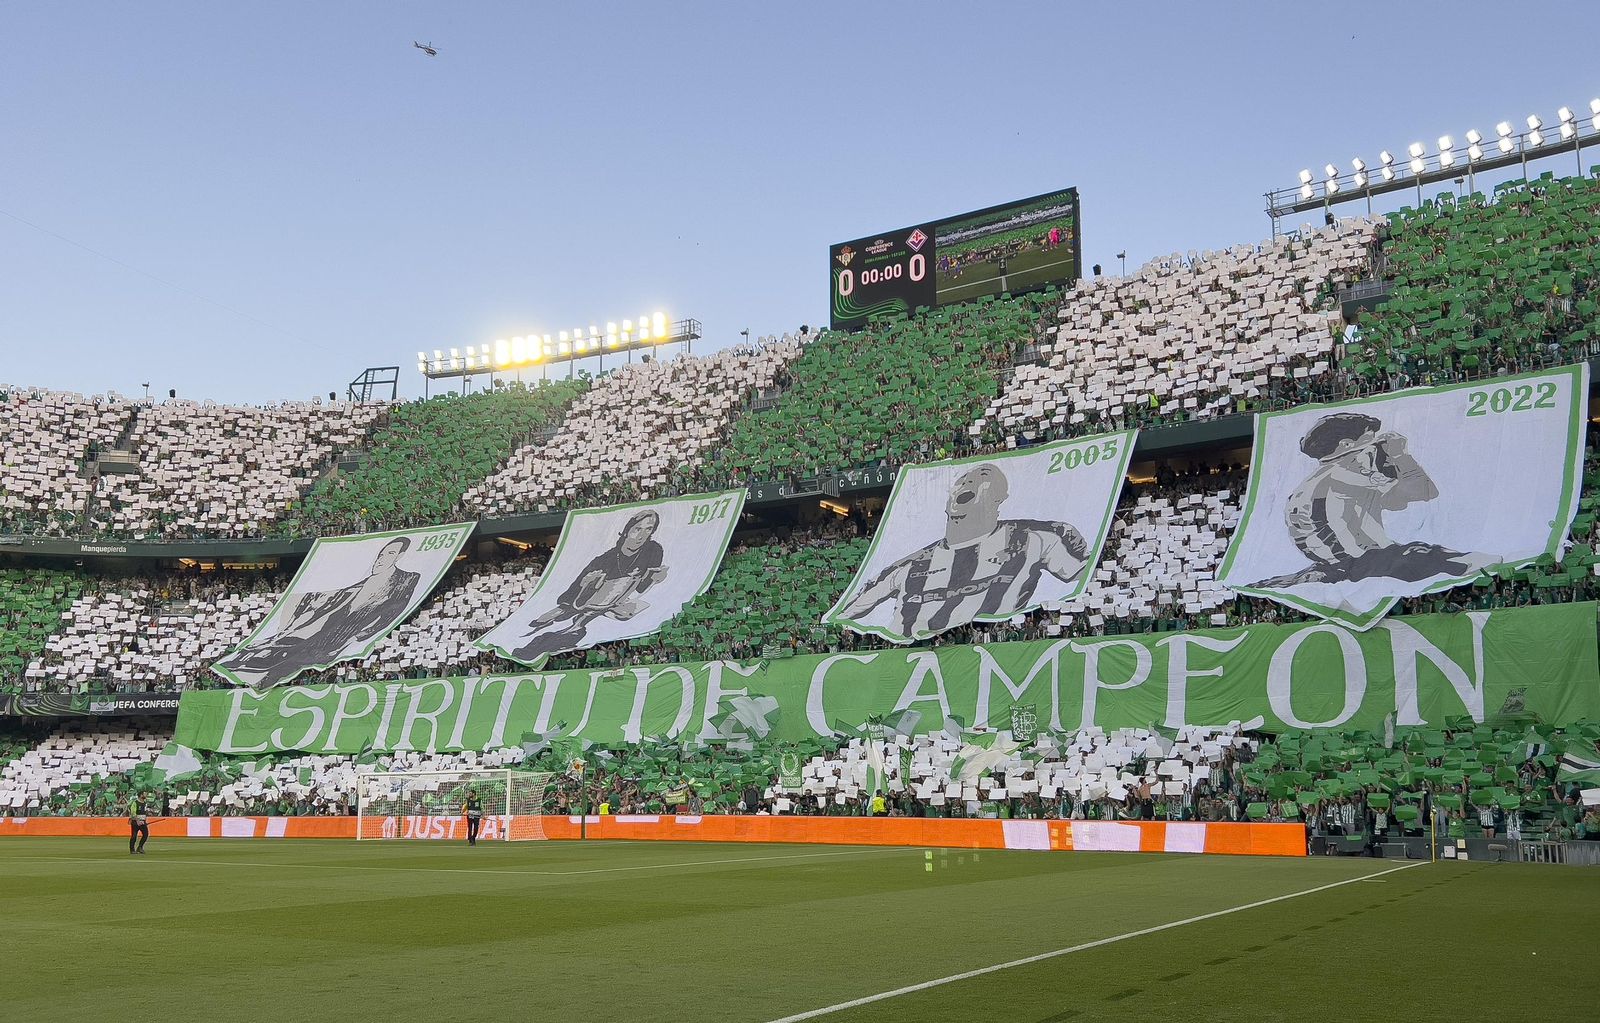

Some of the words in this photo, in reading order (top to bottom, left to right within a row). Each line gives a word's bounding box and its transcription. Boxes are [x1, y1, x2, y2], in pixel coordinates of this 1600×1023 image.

[861, 263, 902, 285] 00:00
[909, 254, 926, 282] 0
[839, 269, 853, 296] 0
[1466, 382, 1557, 416] 2022
[1047, 439, 1118, 474] 2005
[688, 498, 732, 524] 1977
[81, 545, 127, 553] Manquepierda
[416, 532, 459, 551] 1935
[216, 671, 606, 755] ESPIRITU
[621, 660, 763, 747] DE
[403, 815, 463, 840] JUST
[466, 815, 514, 839] AT
